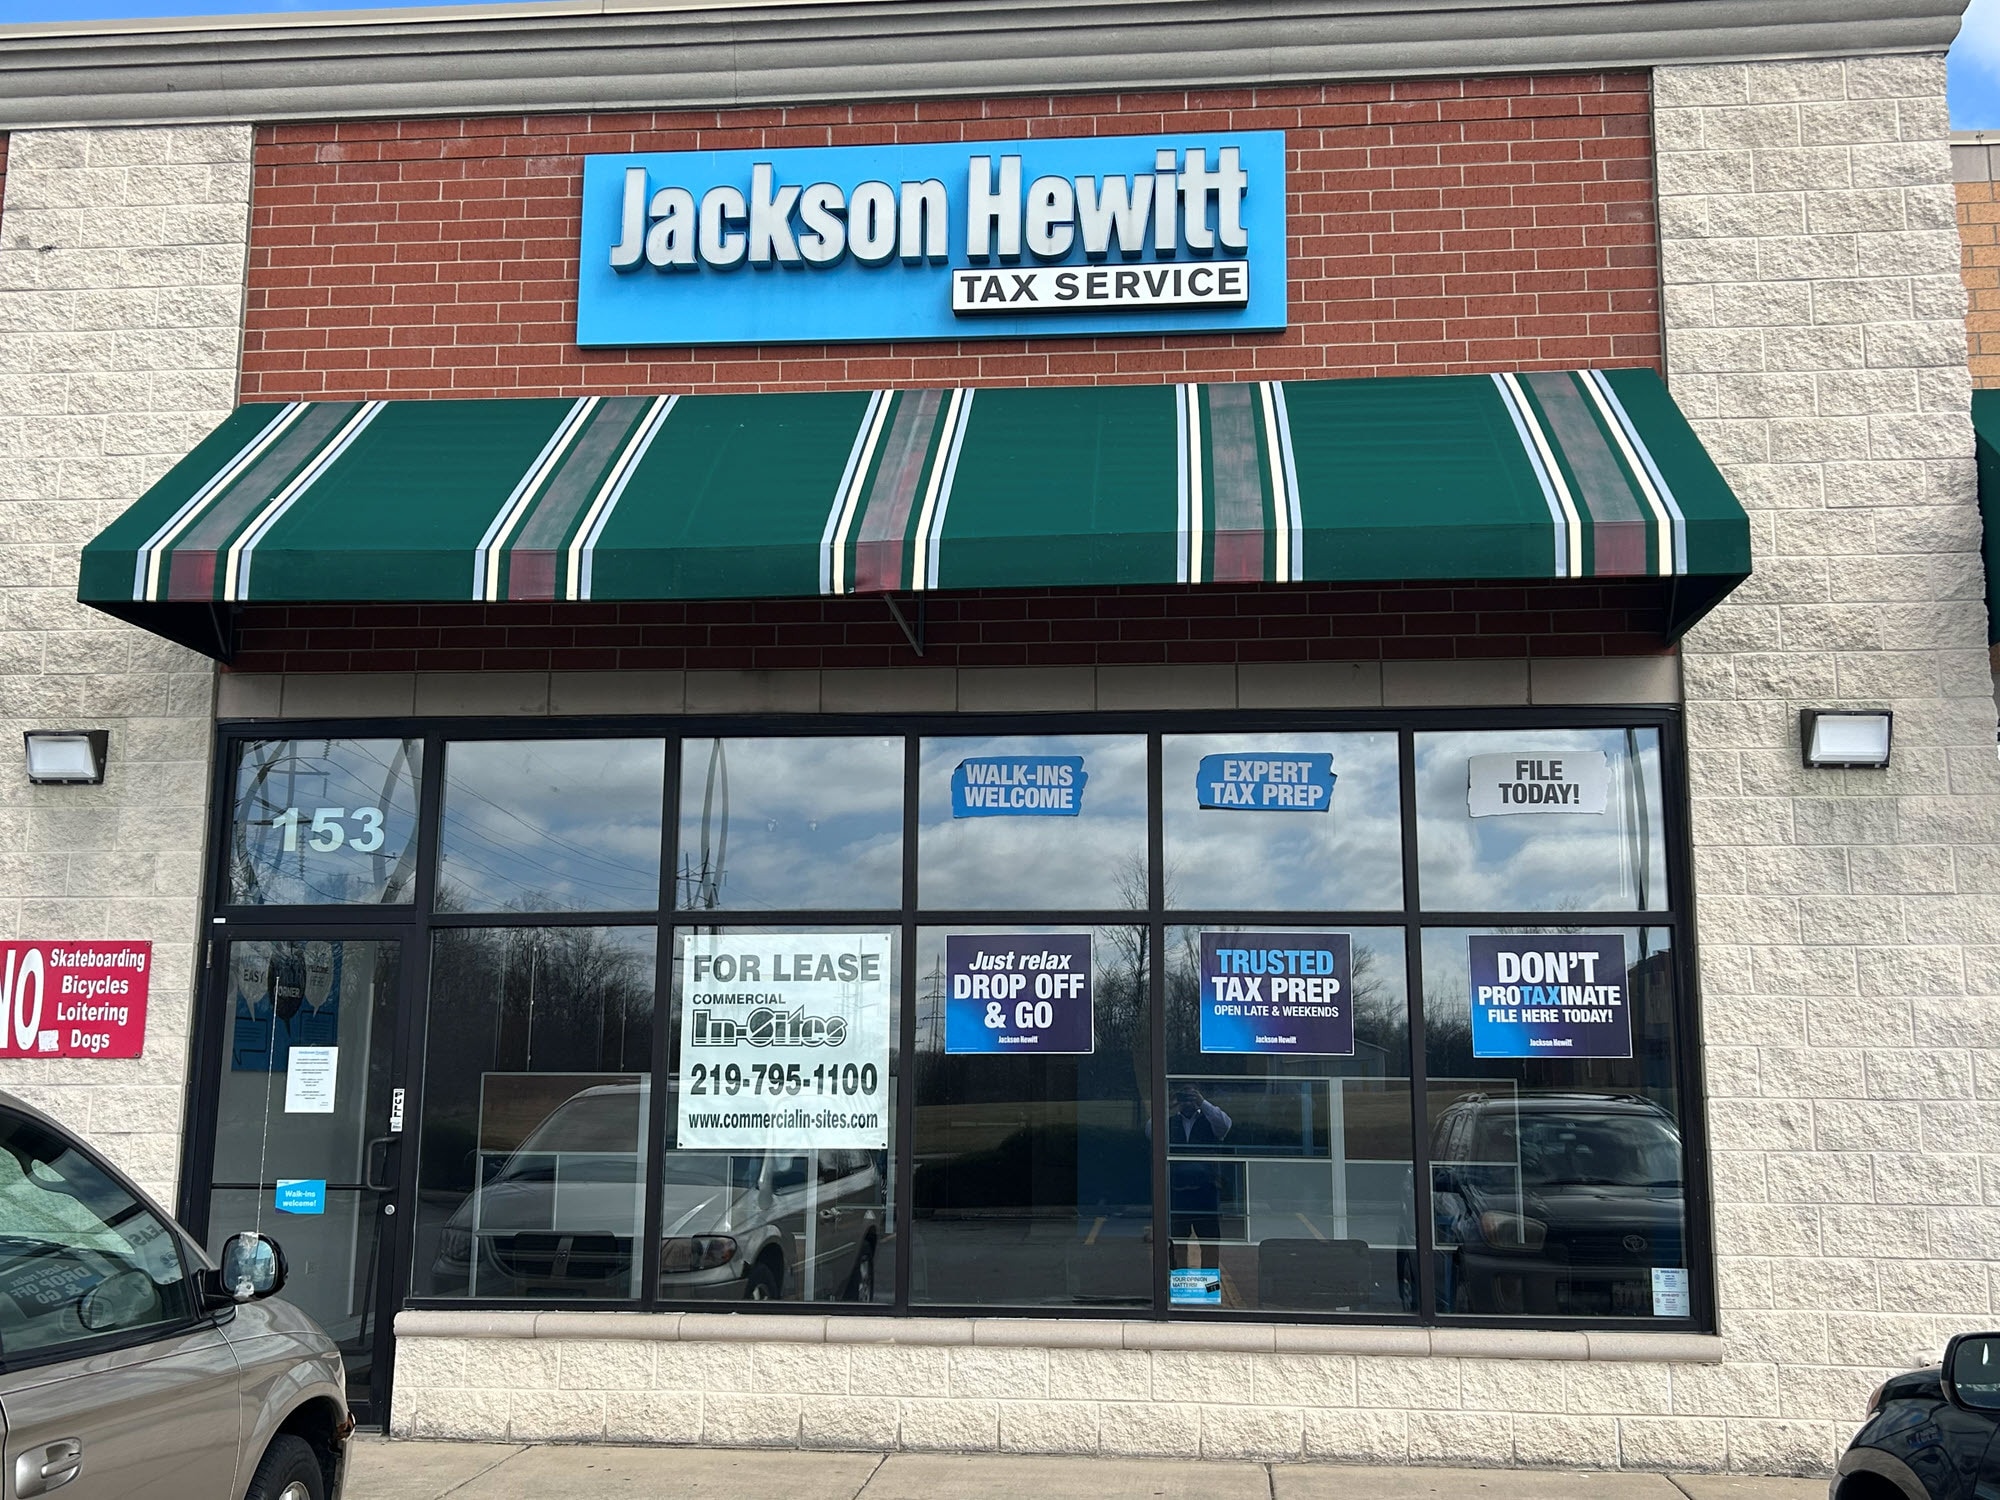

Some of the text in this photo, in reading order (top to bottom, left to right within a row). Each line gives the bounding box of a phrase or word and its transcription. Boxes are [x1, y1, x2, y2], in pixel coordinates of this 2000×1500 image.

[609, 146, 1248, 268] Jackson Hewitt
[960, 267, 1241, 303] TAX SERVICE
[966, 764, 1073, 786] WALK-INS
[1223, 760, 1312, 783] EXPERT
[1516, 760, 1563, 780] FILE
[964, 786, 1073, 808] WELCOME
[1210, 783, 1324, 806] TAX PREP
[1498, 783, 1580, 804] TODAY!
[272, 806, 385, 852] 153
[50, 949, 145, 972] Skateboarding
[693, 953, 881, 982] FOR LEASE
[969, 951, 1072, 970] Just relax
[1216, 949, 1334, 975] TRUSTED
[1497, 951, 1599, 983] DON'T
[61, 975, 129, 999] Bicycles
[243, 968, 265, 983] EASY
[954, 973, 1085, 999] DROP OFF
[692, 993, 786, 1005] COMMERCIAL
[1211, 976, 1340, 1003] TAX PREP
[1478, 985, 1621, 1006] PROTAXINATE
[57, 1002, 129, 1026] Loitering
[984, 1001, 1053, 1028] & GO
[1214, 1005, 1339, 1018] OPEN LATE & WEEKENDS
[1488, 1009, 1613, 1022] FILE HERE TODAY!
[692, 1004, 848, 1047] In-Sites
[70, 1029, 111, 1053] Dogs
[998, 1035, 1020, 1044] Jackson
[1255, 1035, 1278, 1044] Jackson
[1529, 1038, 1553, 1047] Jackson
[690, 1063, 878, 1095] 219-795-1100
[393, 1091, 403, 1118] PULL
[689, 1109, 878, 1129] www.commercialin-sites.com
[282, 1199, 317, 1207] welcome!
[285, 1190, 316, 1198] Walk-ins
